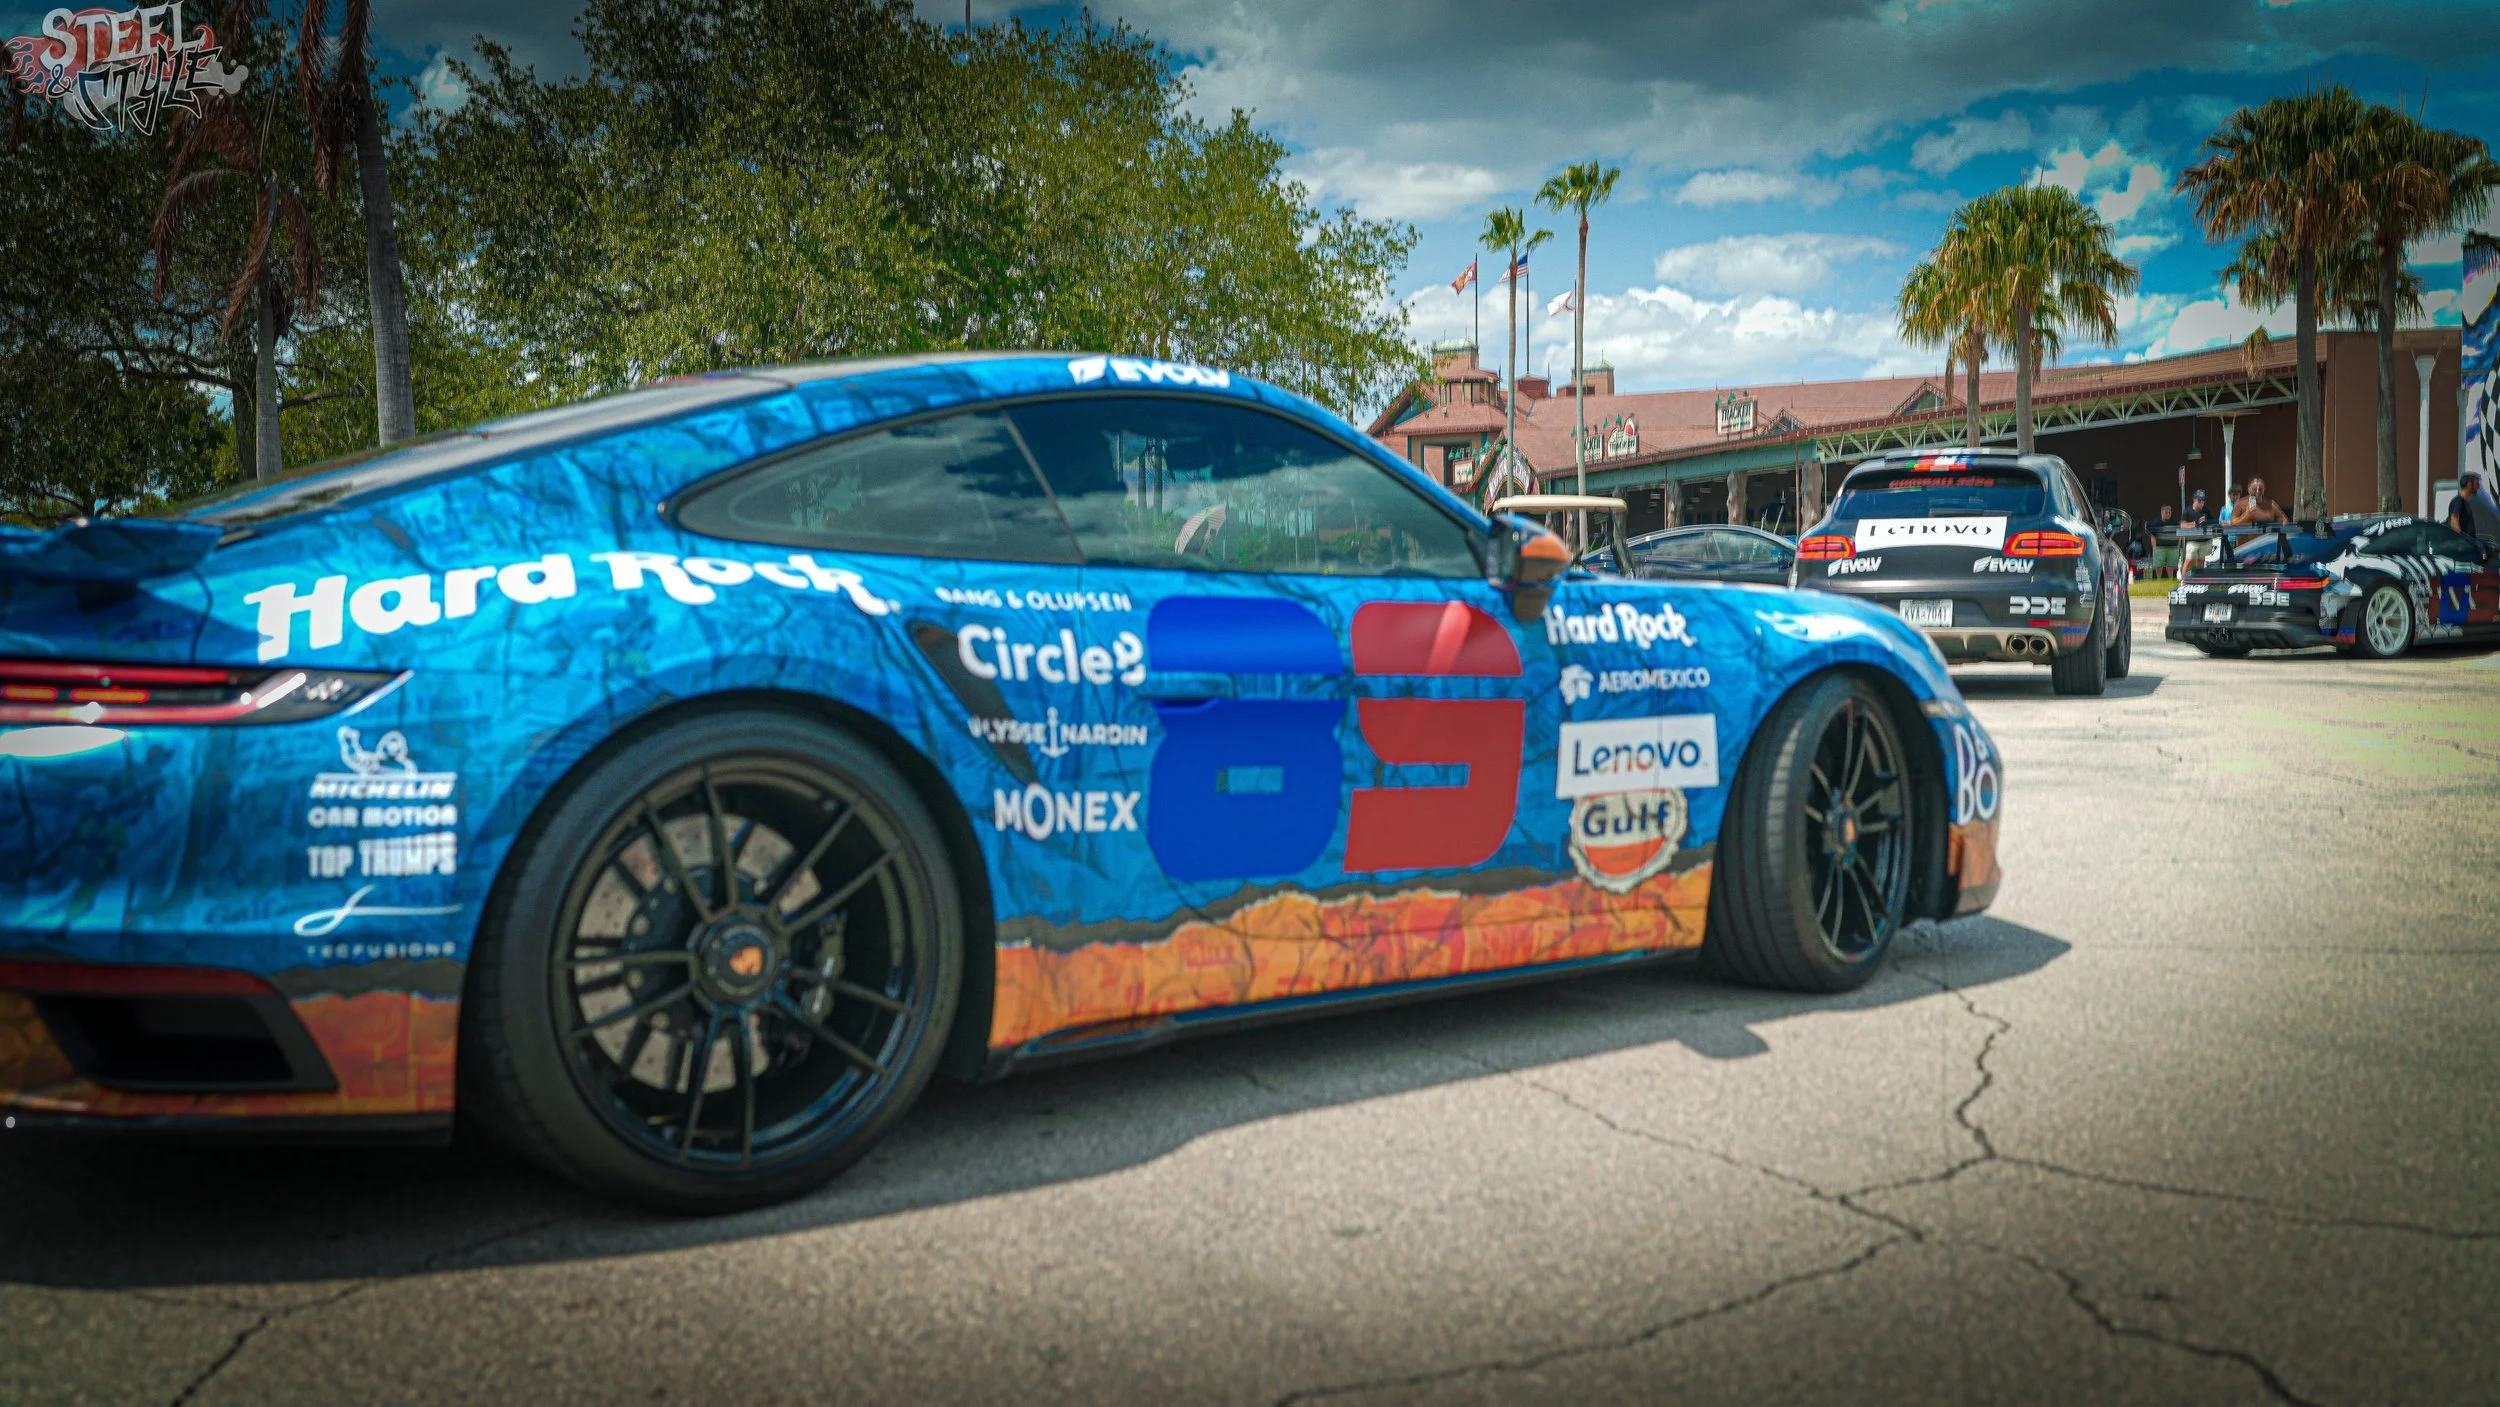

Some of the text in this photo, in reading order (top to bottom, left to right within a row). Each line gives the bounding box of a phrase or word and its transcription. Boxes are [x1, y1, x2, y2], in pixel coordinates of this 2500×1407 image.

[1840, 556, 1882, 574] EVOLV
[1988, 557, 2035, 573] EVOLV
[244, 552, 889, 664] Hard Rock
[1544, 602, 1698, 650] Hard Rock
[1598, 666, 1712, 693] AEROMEXICO
[968, 715, 1148, 746] ULYSSE NARDIN
[1147, 594, 1526, 883] 83
[1573, 738, 1701, 777] Lenovo
[309, 782, 455, 799] MICHELIN
[308, 806, 358, 828] CAR
[993, 781, 1141, 841] MONEX
[1583, 799, 1672, 838] Gulf
[307, 845, 354, 878] TOP
